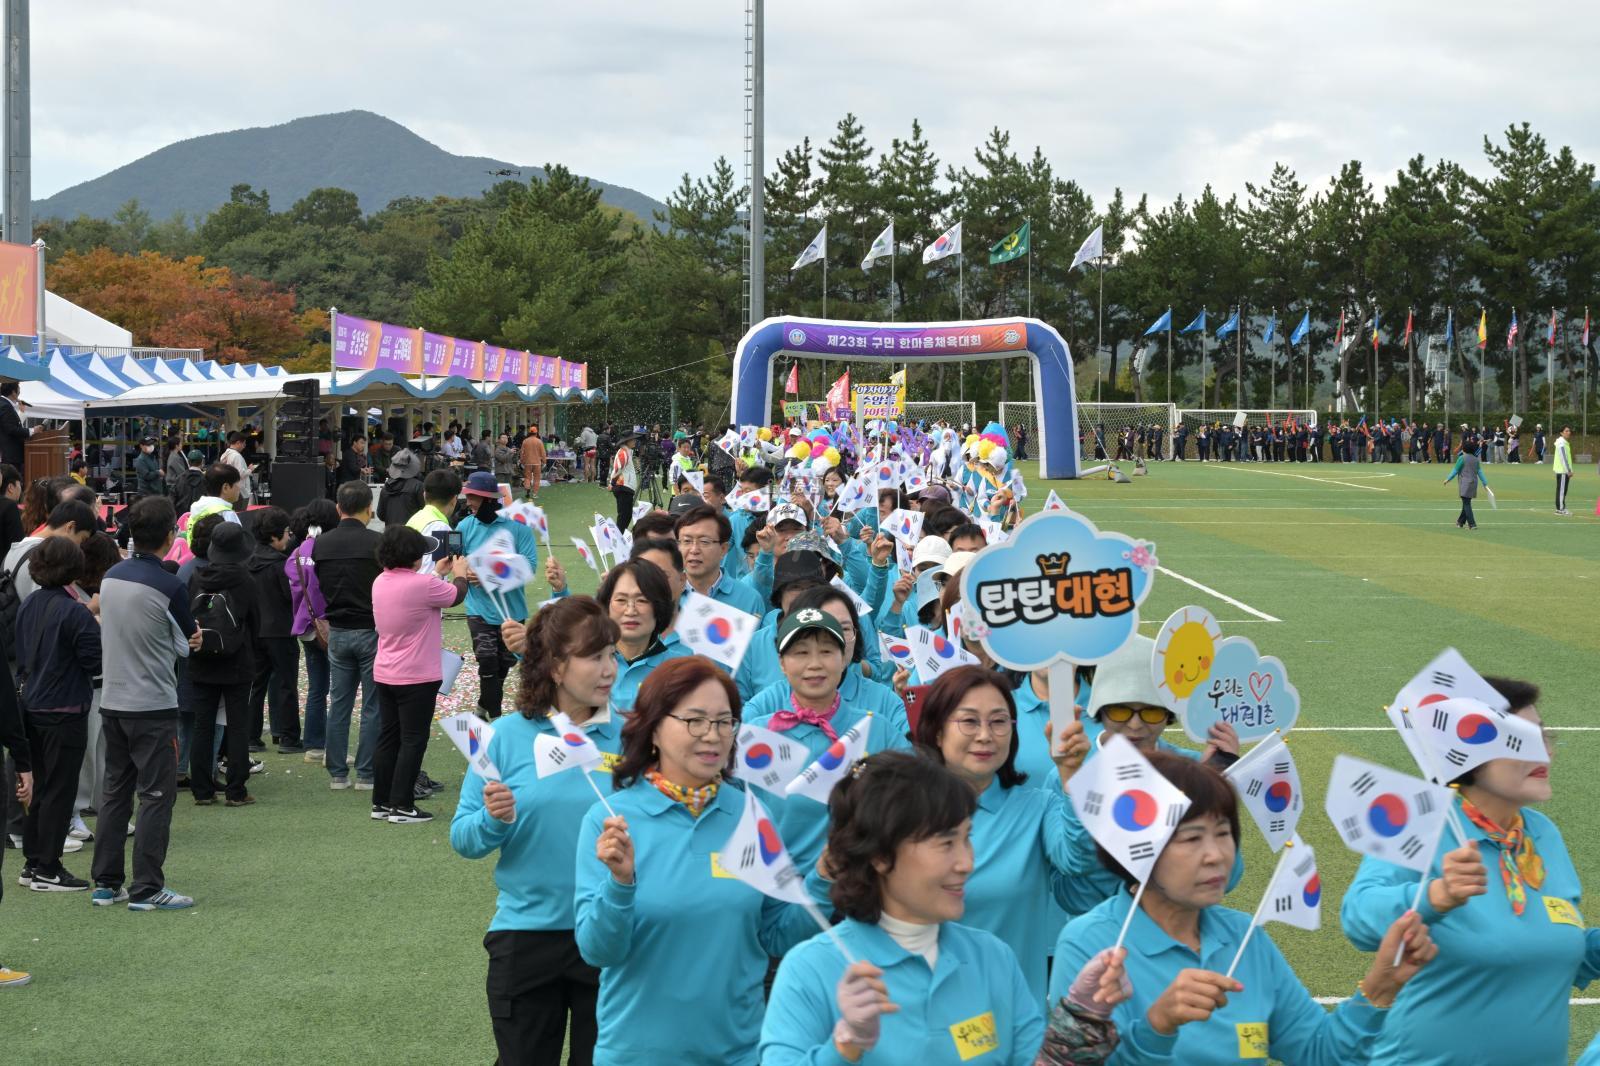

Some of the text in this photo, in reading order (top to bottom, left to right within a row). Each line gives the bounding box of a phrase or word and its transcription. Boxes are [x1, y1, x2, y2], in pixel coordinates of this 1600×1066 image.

[827, 334, 982, 349] 제23회 구민 한마음체육대회
[978, 570, 1133, 626] 탄탄대현
[1208, 678, 1243, 709] 우리는
